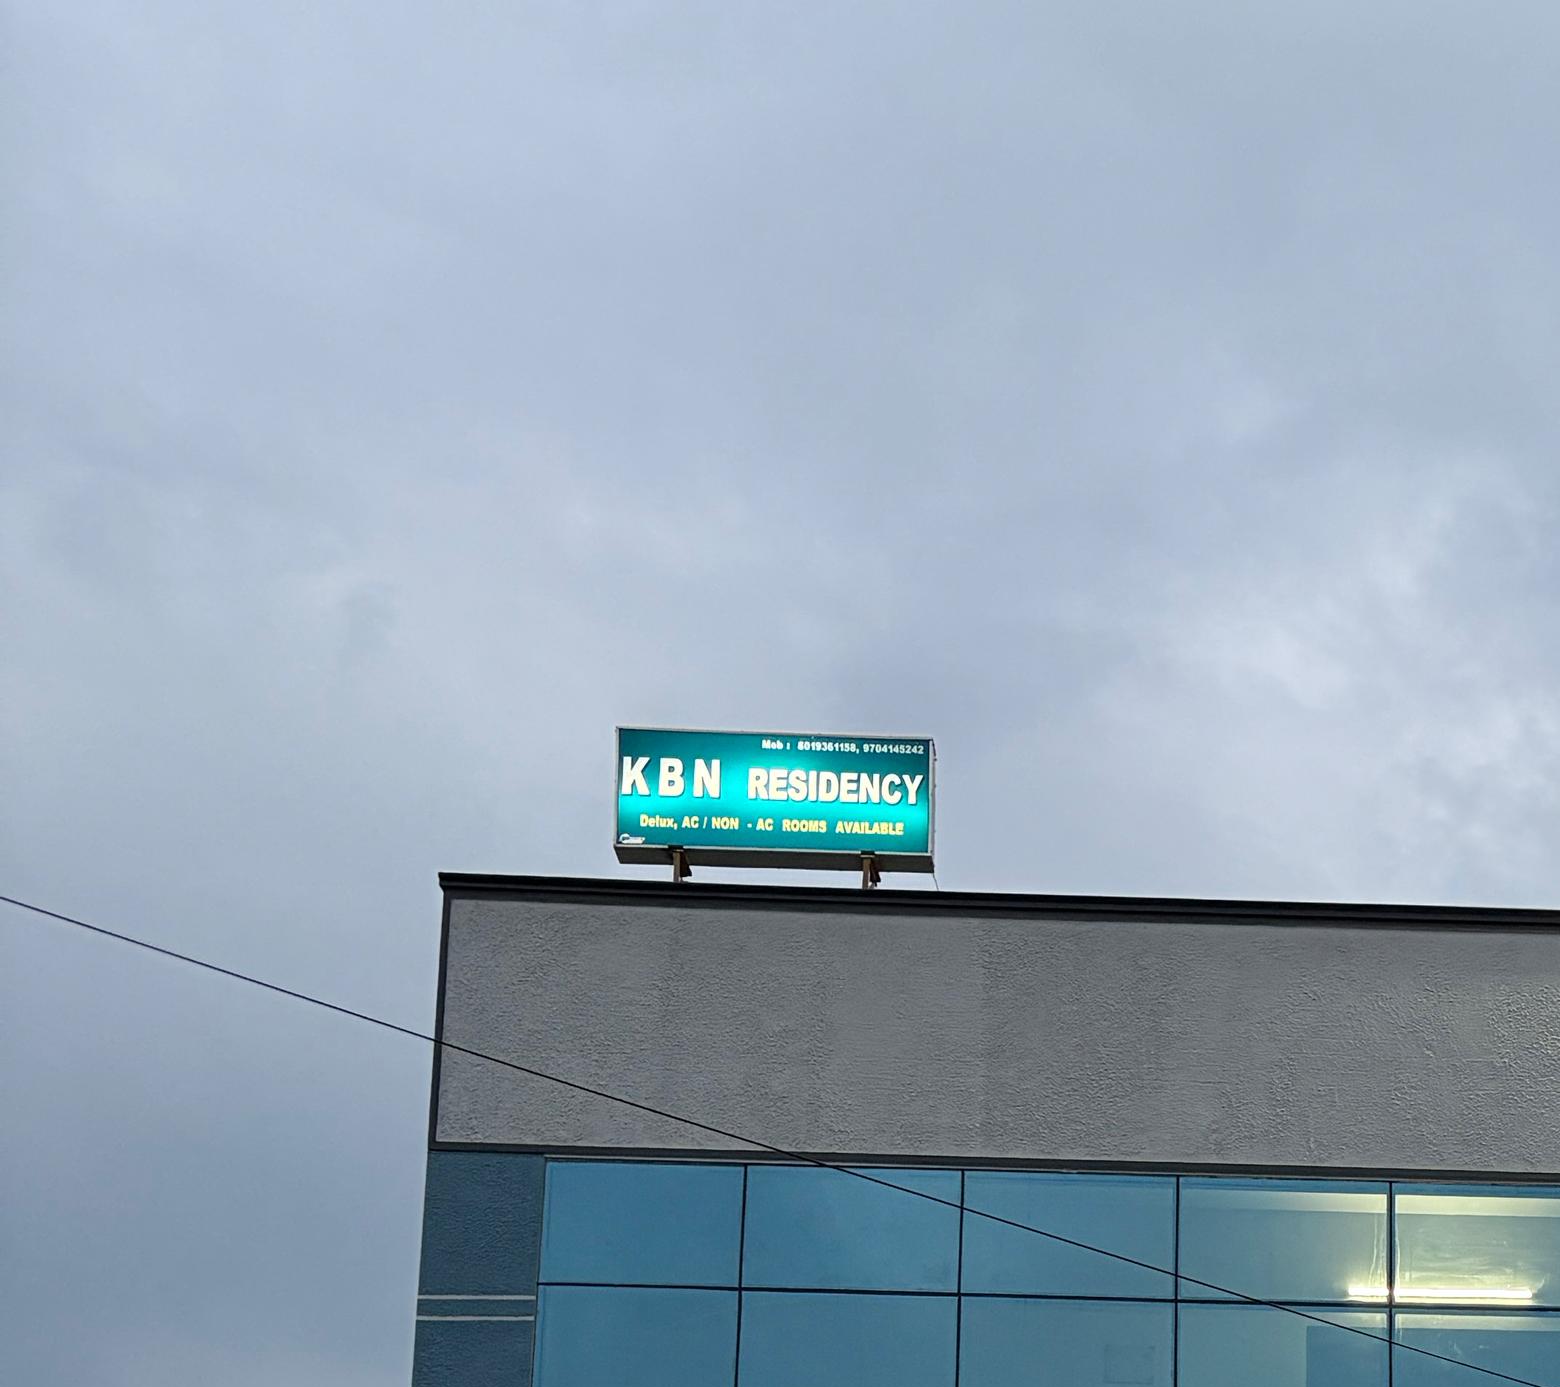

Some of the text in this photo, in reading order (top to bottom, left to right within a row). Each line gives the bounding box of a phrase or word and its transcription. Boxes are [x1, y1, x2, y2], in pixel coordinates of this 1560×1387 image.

[761, 739, 784, 750] Mob
[863, 743, 924, 754] 9704145242
[747, 767, 924, 805] RESIDENCY
[782, 819, 827, 833] ROOMS
[835, 821, 904, 836] AVAILABLE
